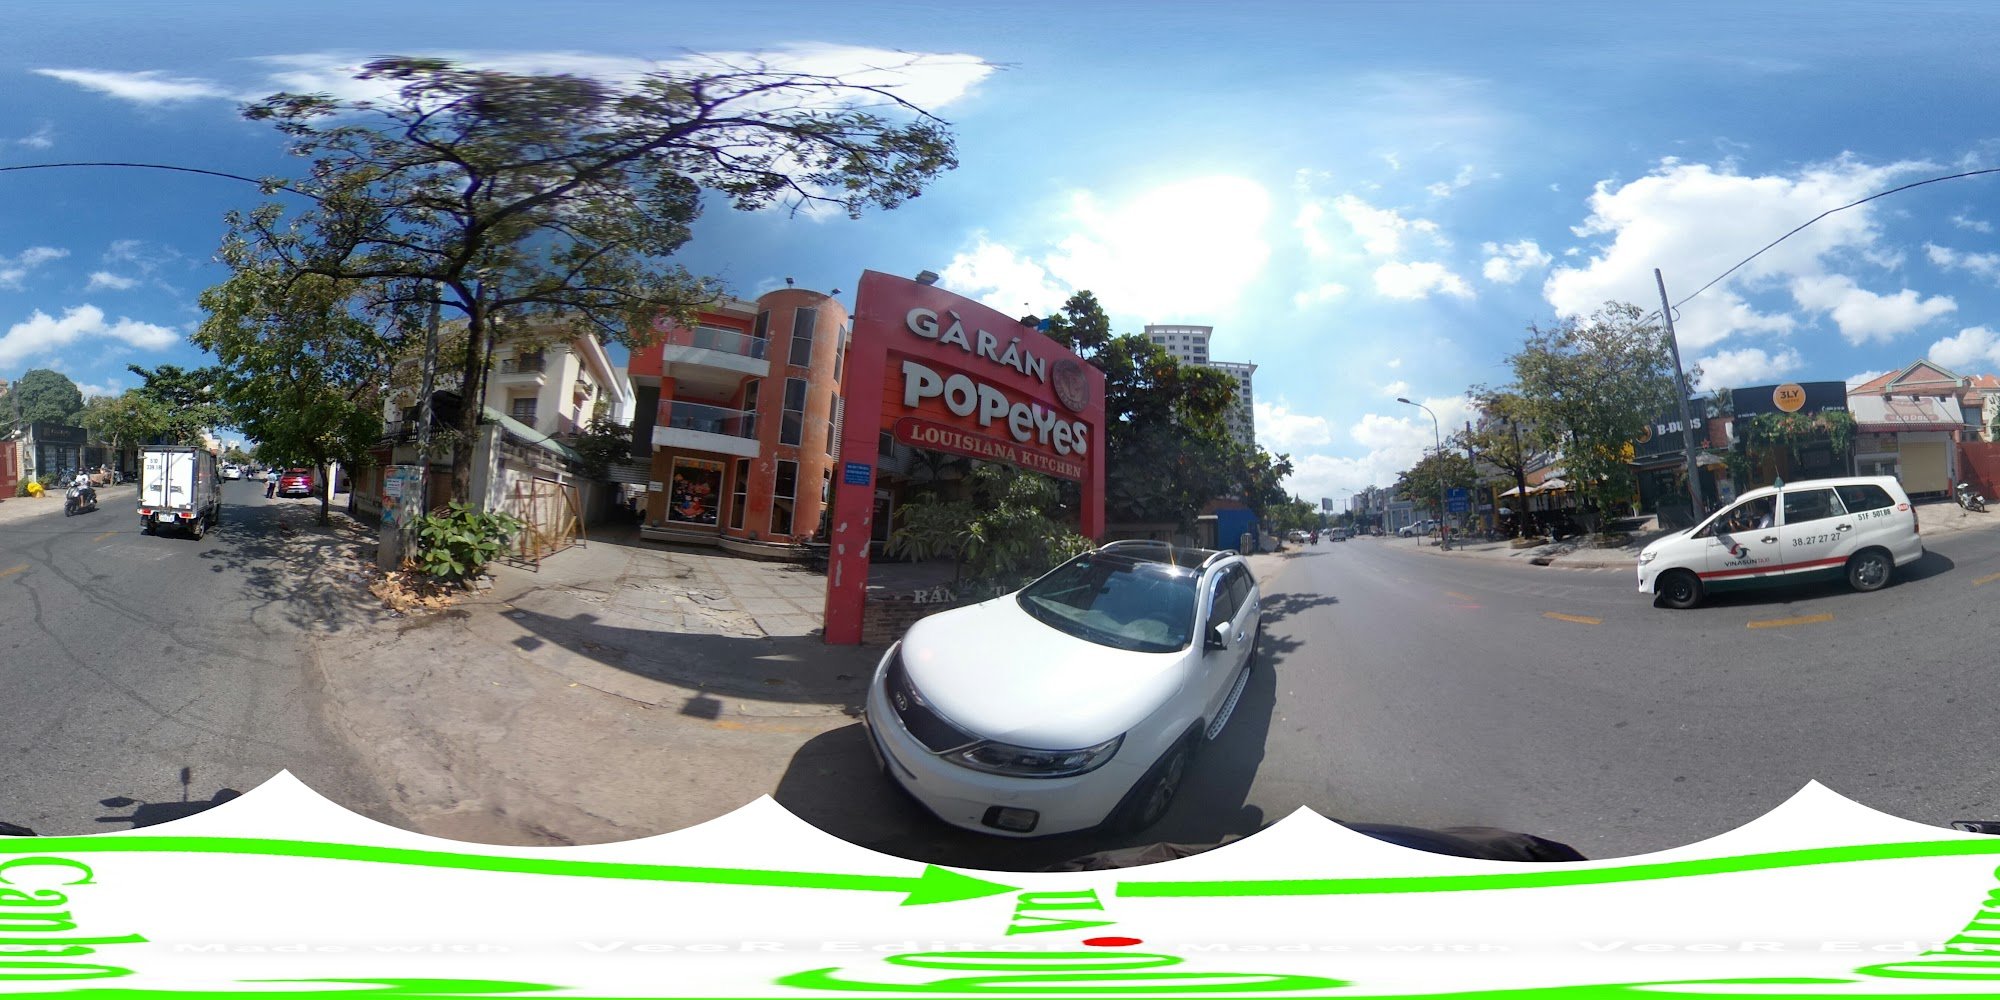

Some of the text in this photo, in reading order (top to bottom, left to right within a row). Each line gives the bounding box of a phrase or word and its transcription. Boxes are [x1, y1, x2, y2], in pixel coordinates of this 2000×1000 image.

[906, 307, 1046, 384] GÀ RÁN
[1656, 418, 1702, 436] B-DUS
[910, 424, 1082, 478] LOUISIANA KITCHEN
[1818, 534, 1829, 544] 27
[1831, 532, 1842, 542] 27
